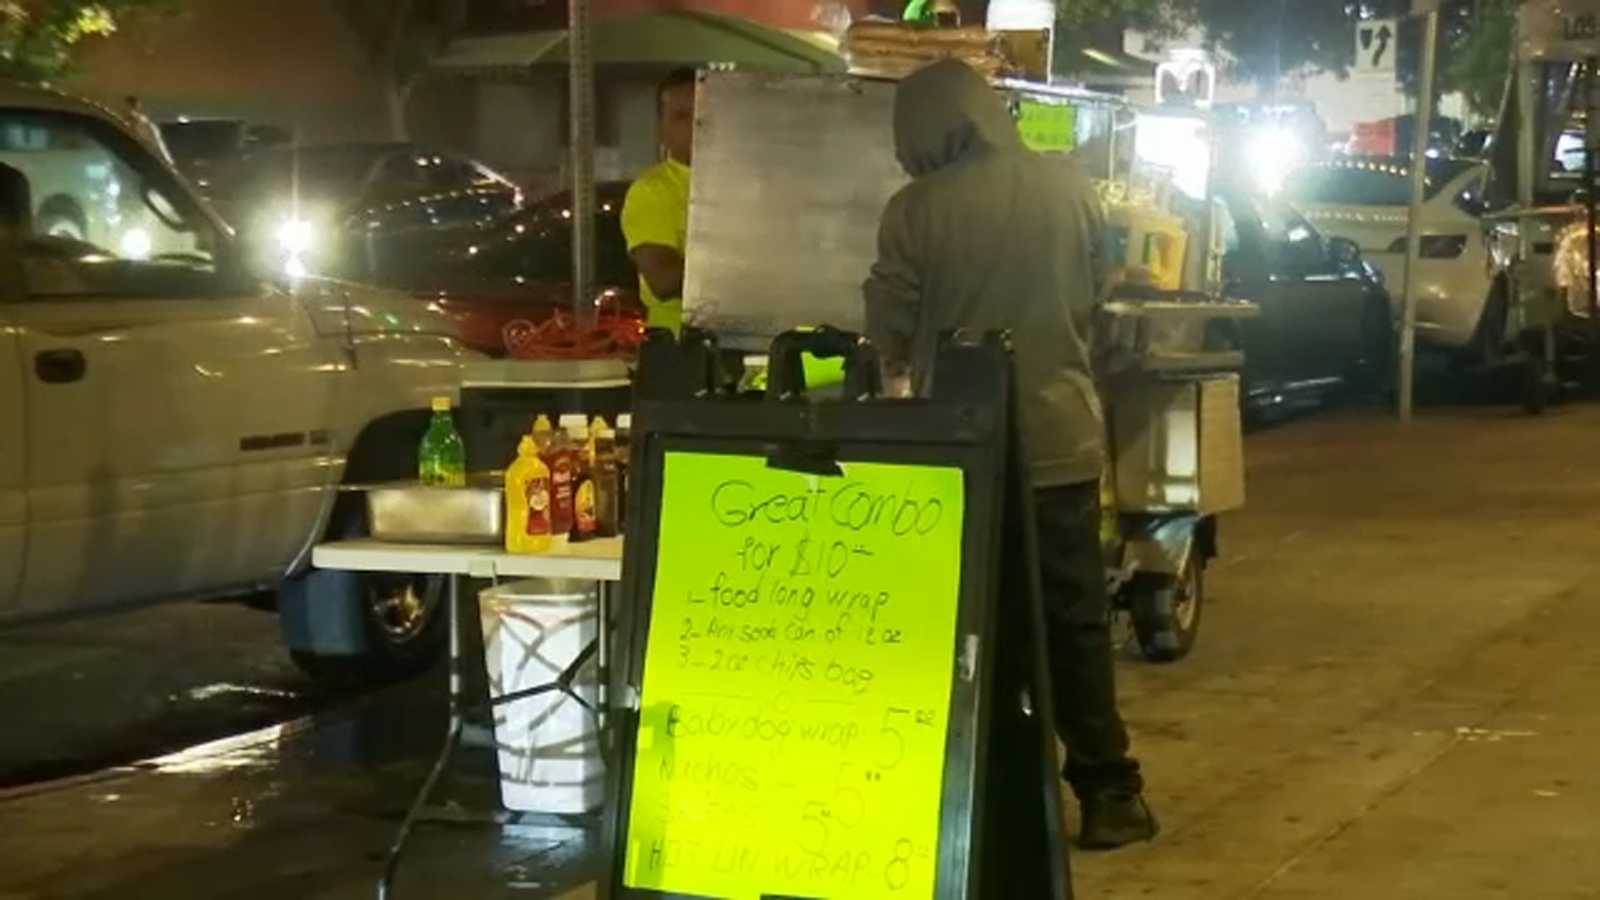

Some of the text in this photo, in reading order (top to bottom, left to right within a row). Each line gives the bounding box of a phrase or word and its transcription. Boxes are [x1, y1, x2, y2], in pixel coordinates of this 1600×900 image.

[711, 479, 943, 536] Great Combo
[736, 536, 780, 570] for
[710, 570, 766, 609] food
[769, 579, 814, 621] long
[827, 587, 890, 622] wrap
[824, 612, 852, 643] of
[824, 652, 874, 695] bag
[665, 703, 741, 741] Baby
[742, 705, 792, 761] dog
